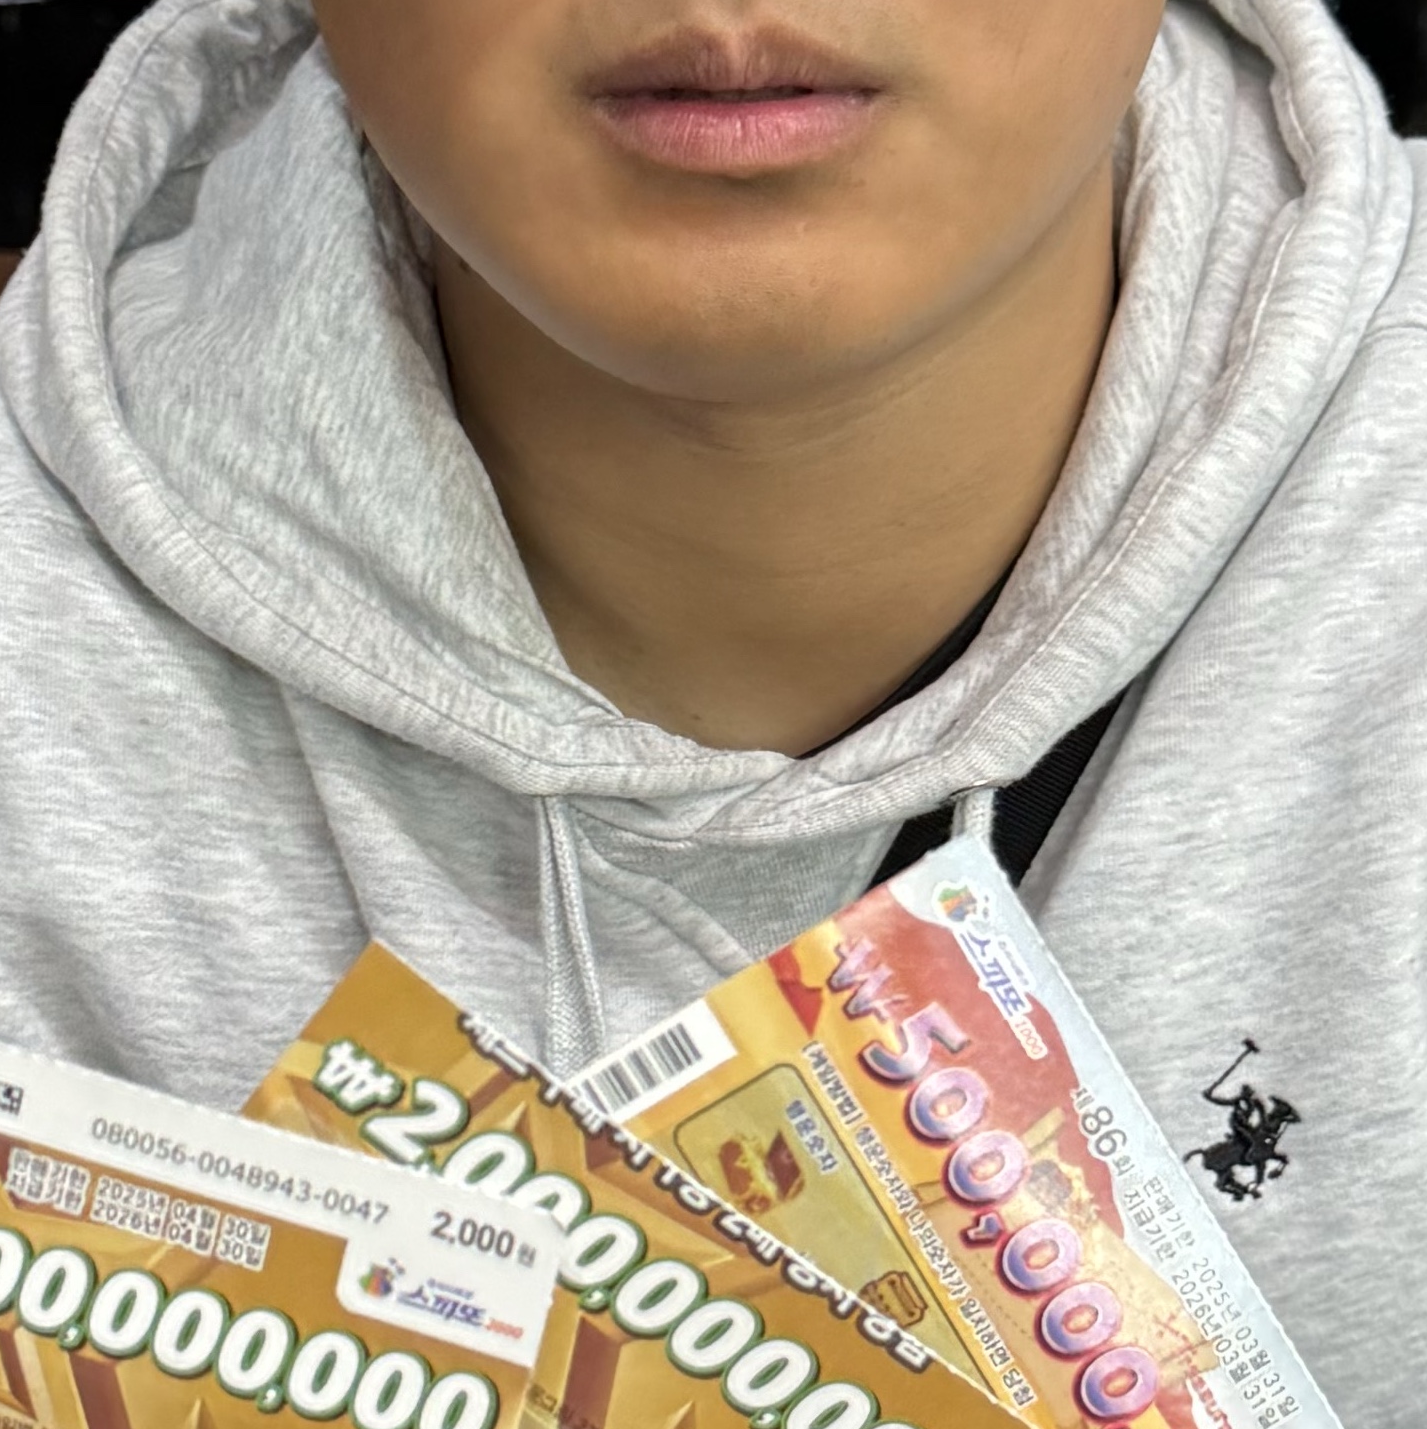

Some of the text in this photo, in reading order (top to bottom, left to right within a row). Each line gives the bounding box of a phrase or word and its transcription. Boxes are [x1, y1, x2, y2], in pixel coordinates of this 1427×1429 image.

[91, 1117, 390, 1226] 080056-0048943-0047
[1117, 1187, 1178, 1264] 지급기한
[1168, 1266, 1224, 1338] 2026년
[1188, 1255, 1243, 1325] 2025년
[1260, 1370, 1301, 1418] 31일
